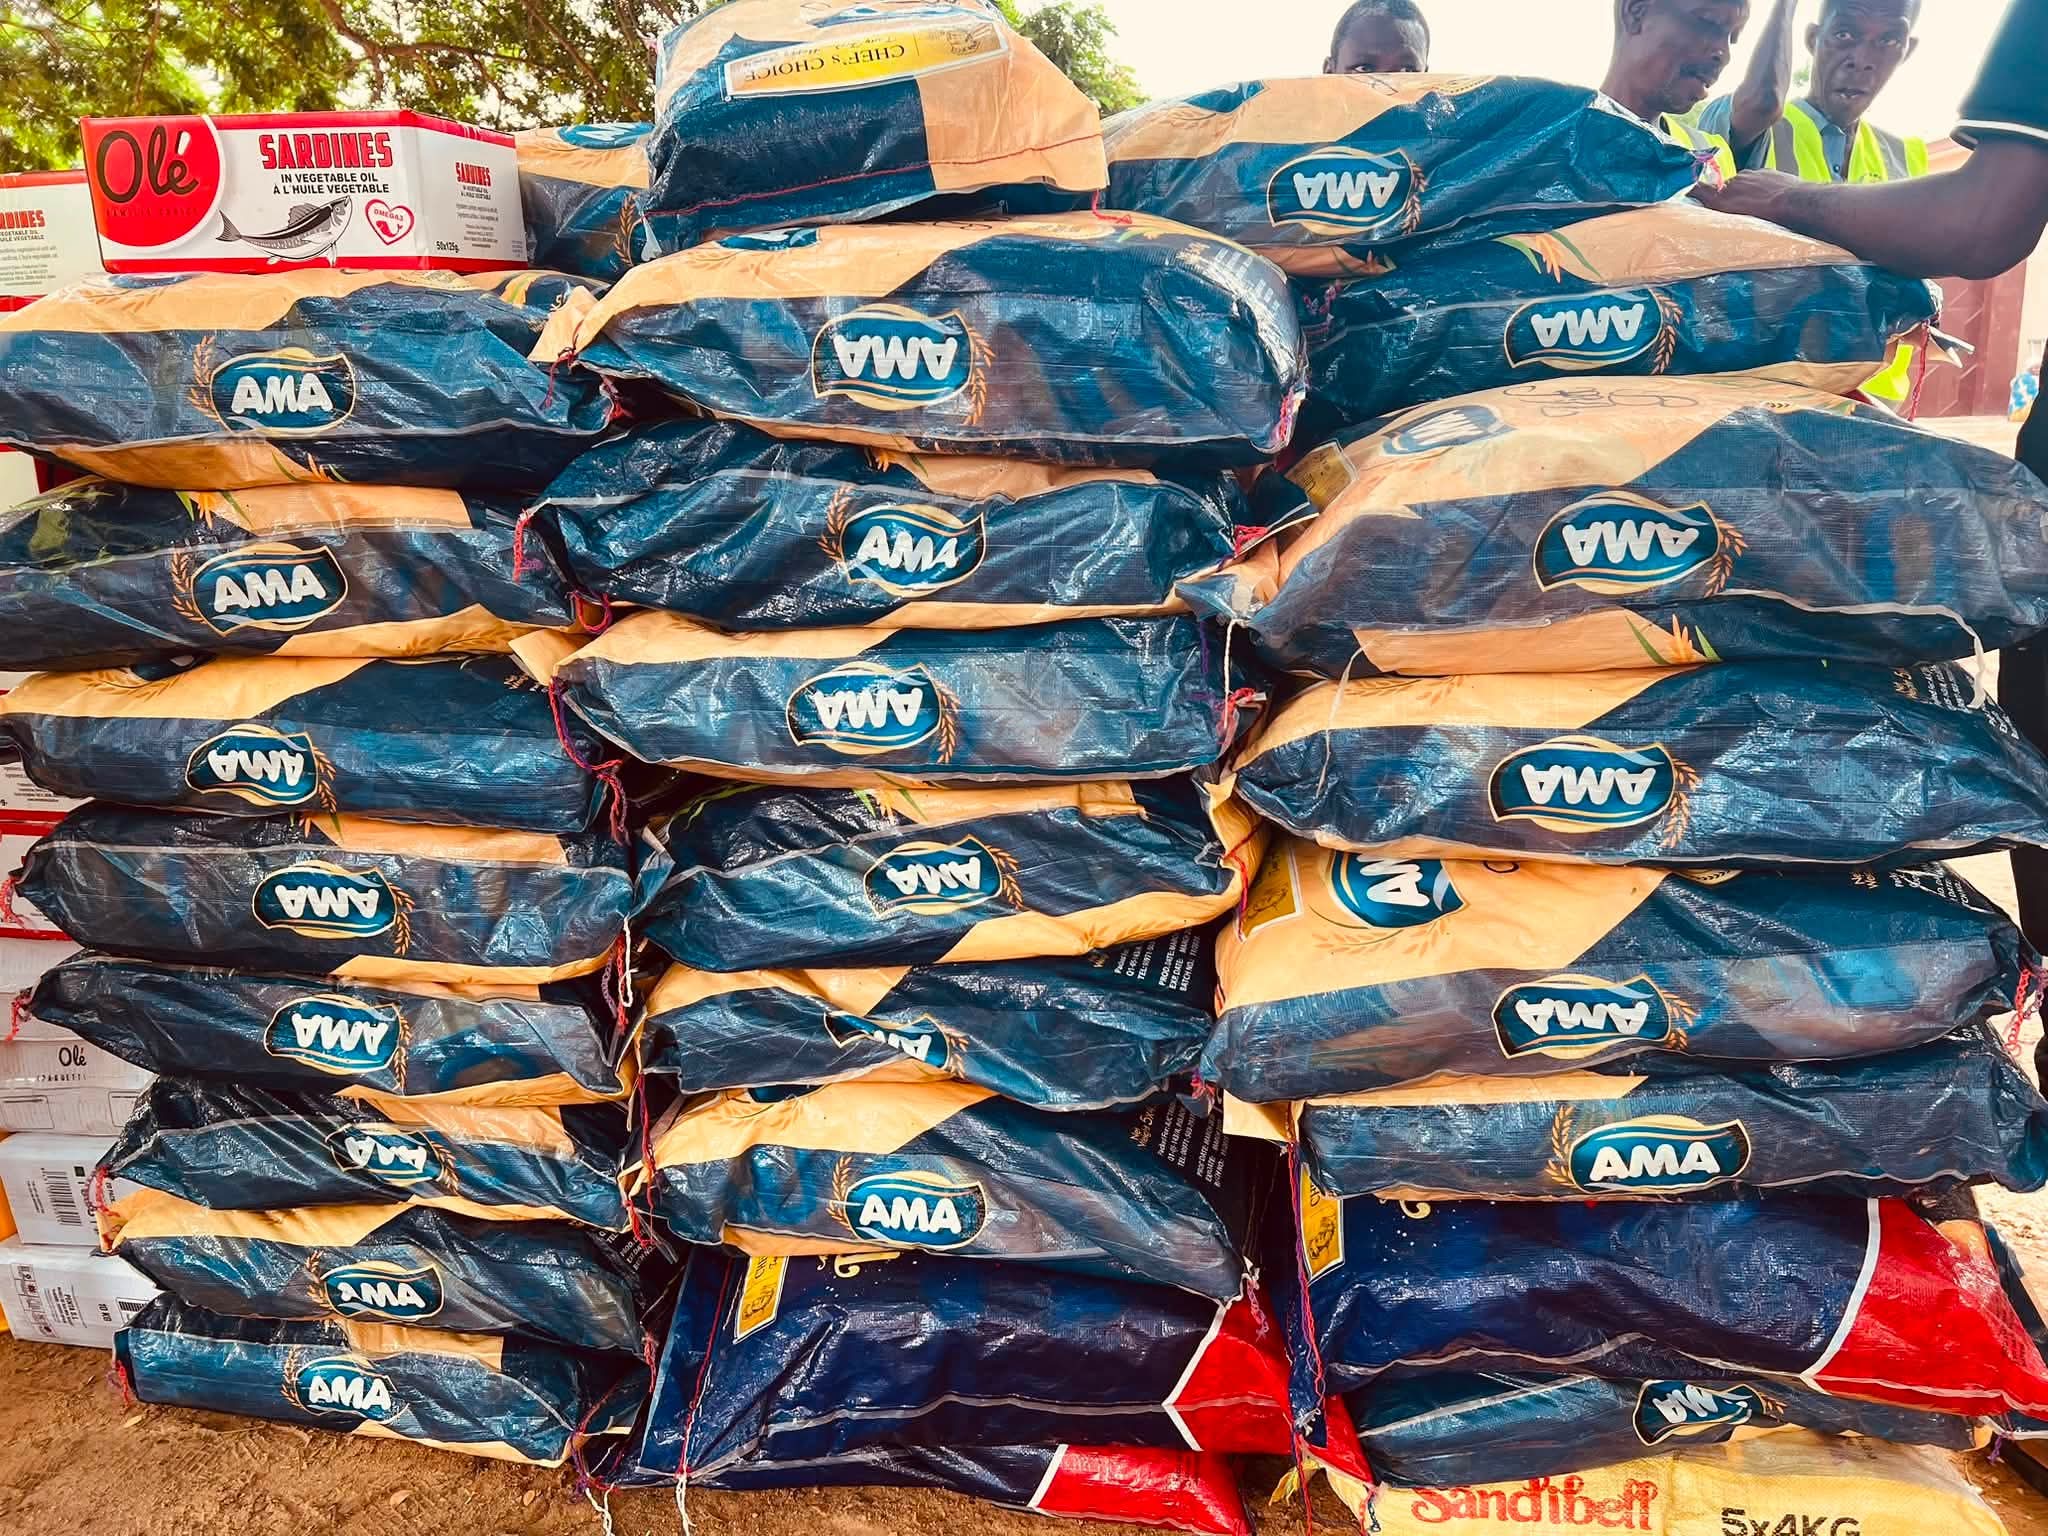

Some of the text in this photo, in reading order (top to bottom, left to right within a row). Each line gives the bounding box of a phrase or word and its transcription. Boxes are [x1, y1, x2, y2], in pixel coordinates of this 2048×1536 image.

[96, 125, 199, 203] Olé
[259, 132, 393, 169] SARDINES
[281, 173, 378, 183] IN VEGETABLE OIL
[328, 184, 390, 194] VEGETABLE
[1292, 170, 1399, 209] AMA
[1531, 303, 1646, 347] AMA
[833, 335, 958, 380] AMA
[231, 372, 333, 415] AMA
[857, 526, 960, 572] AMA
[1562, 520, 1700, 567] AMA
[214, 565, 327, 613] AMA
[815, 688, 923, 730] AMA
[208, 748, 305, 786] AMA
[1520, 764, 1657, 806] AMA
[886, 856, 982, 894] AMA
[275, 883, 379, 918] AMA
[295, 1013, 389, 1055] AMA
[1515, 999, 1649, 1036] AMA
[1590, 1141, 1720, 1184] AMA
[859, 1195, 961, 1235] AMA
[308, 1375, 391, 1410] AMA
